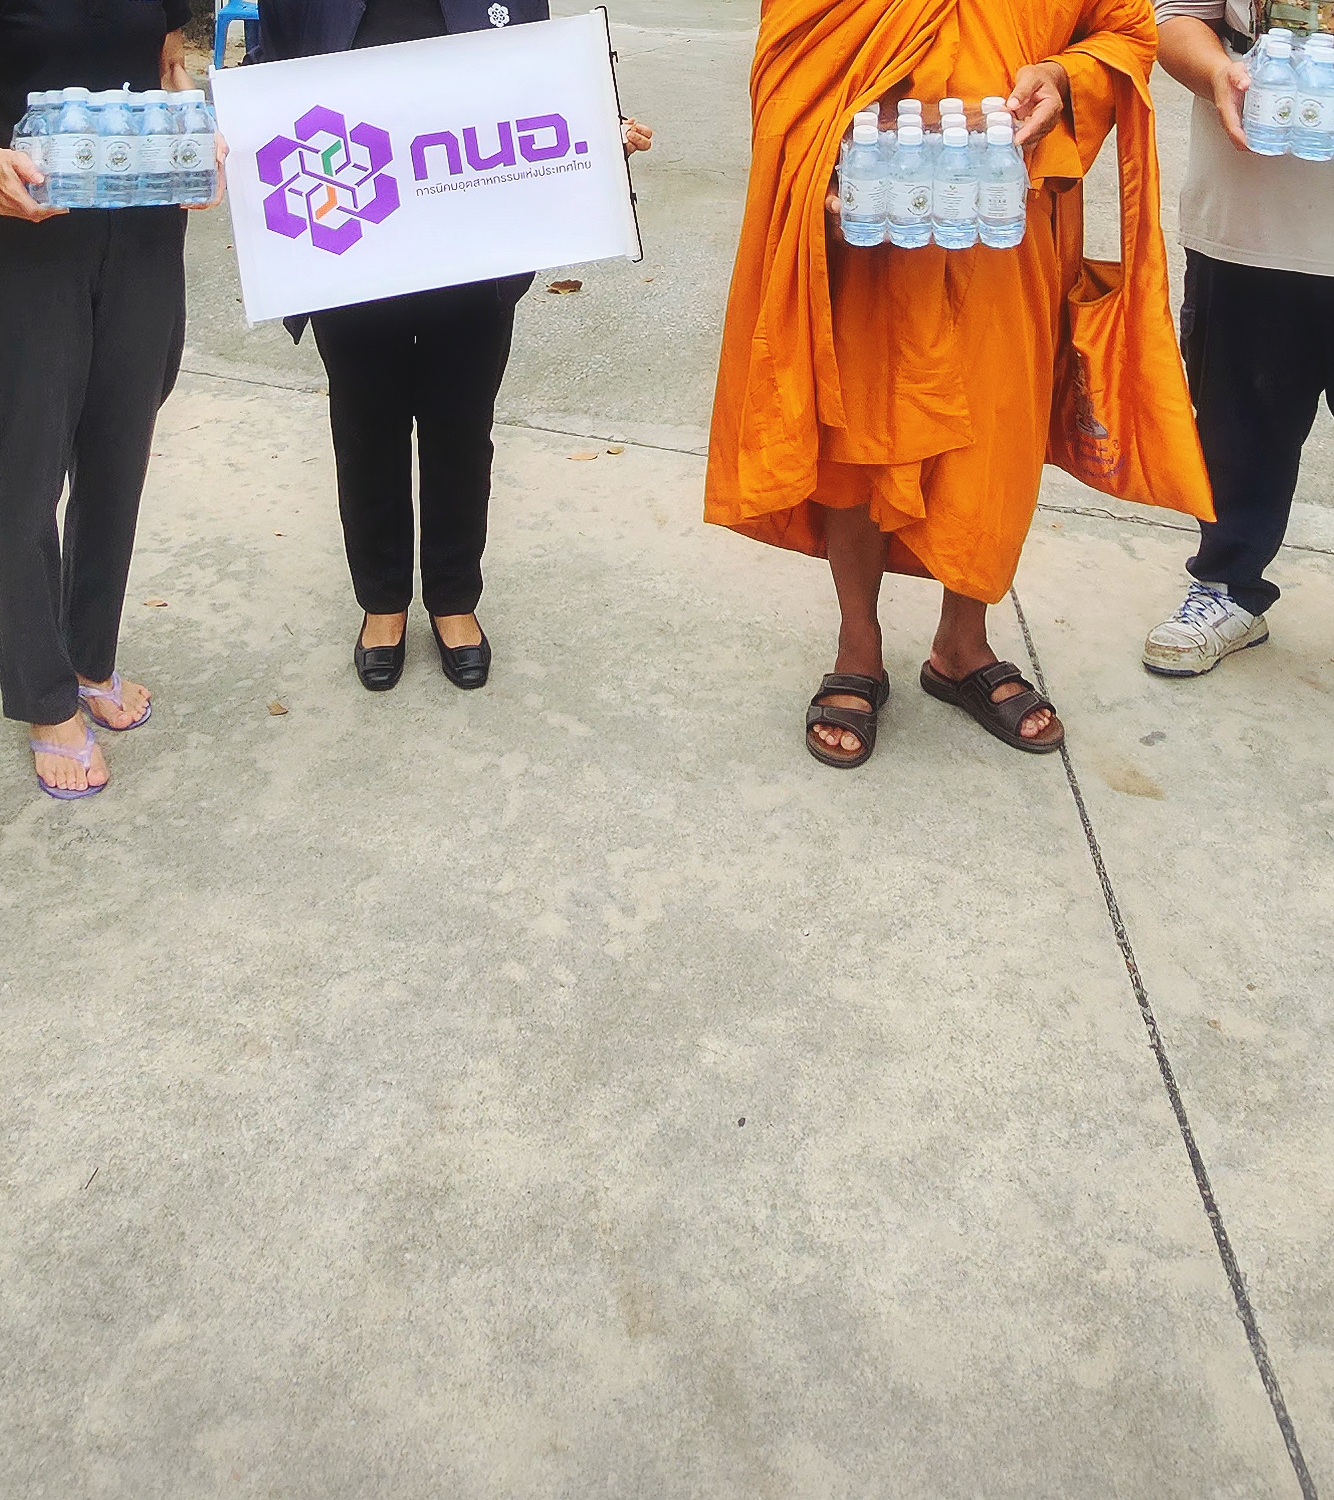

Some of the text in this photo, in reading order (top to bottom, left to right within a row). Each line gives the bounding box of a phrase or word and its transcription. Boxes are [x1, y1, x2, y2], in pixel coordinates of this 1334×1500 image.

[410, 113, 588, 181] กนอ.
[416, 160, 592, 197] การนิคมอุตสาหกรรมแห่งประเทศไทย
